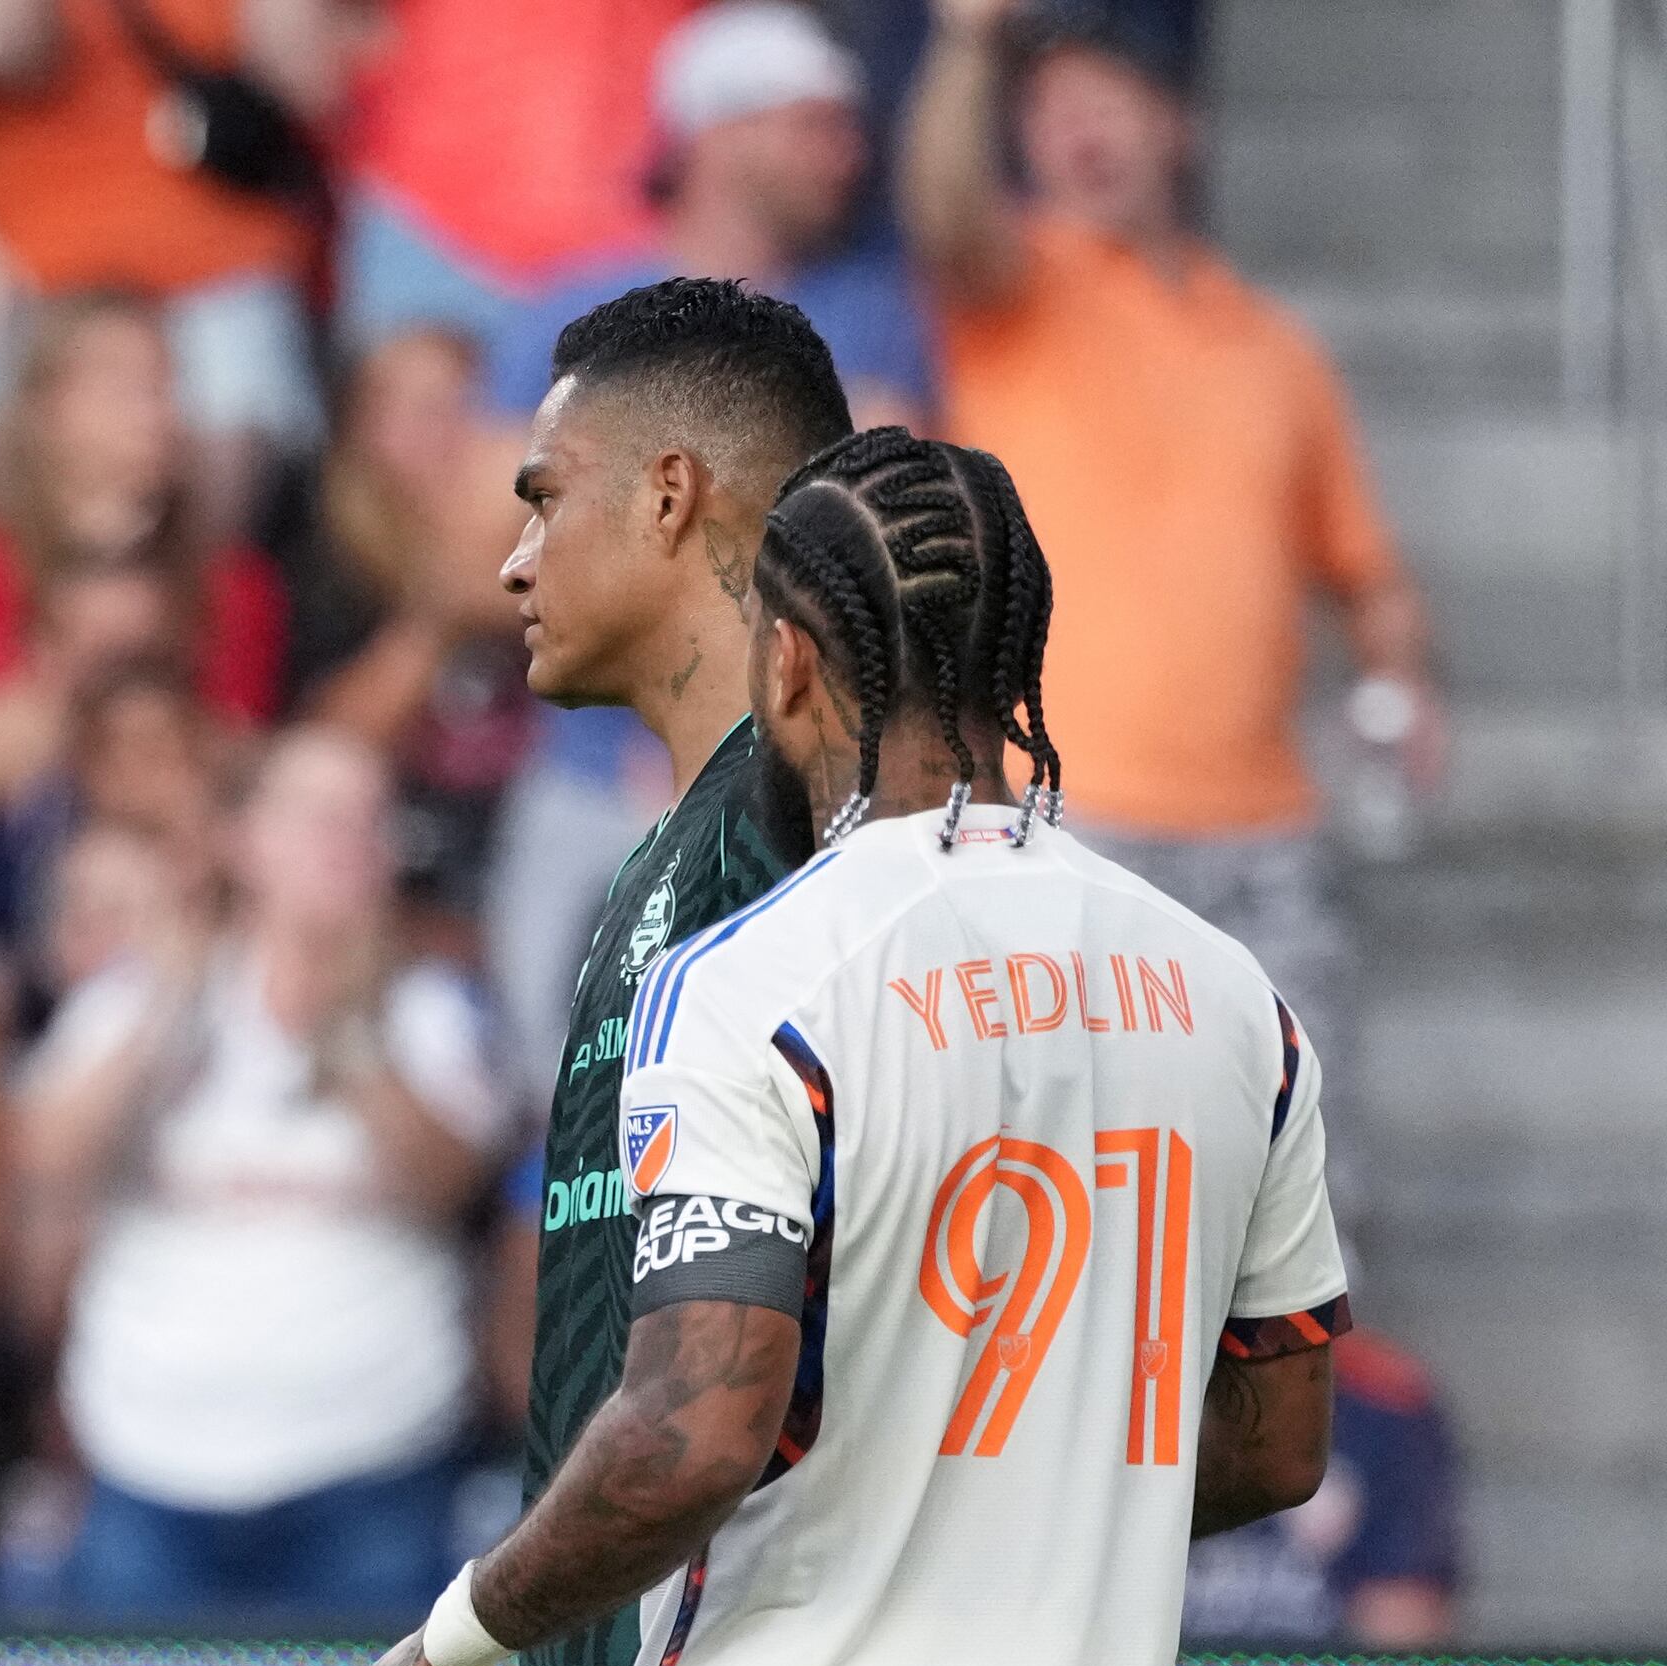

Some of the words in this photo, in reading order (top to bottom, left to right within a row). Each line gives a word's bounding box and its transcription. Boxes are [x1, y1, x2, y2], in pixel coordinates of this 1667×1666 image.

[888, 951, 1194, 1050] YEDLIN
[594, 1014, 629, 1063] SIM
[628, 1116, 653, 1137] MLS
[634, 1196, 809, 1252] LEAGU
[632, 1226, 732, 1285] CUP
[917, 1126, 1194, 1466] 91
